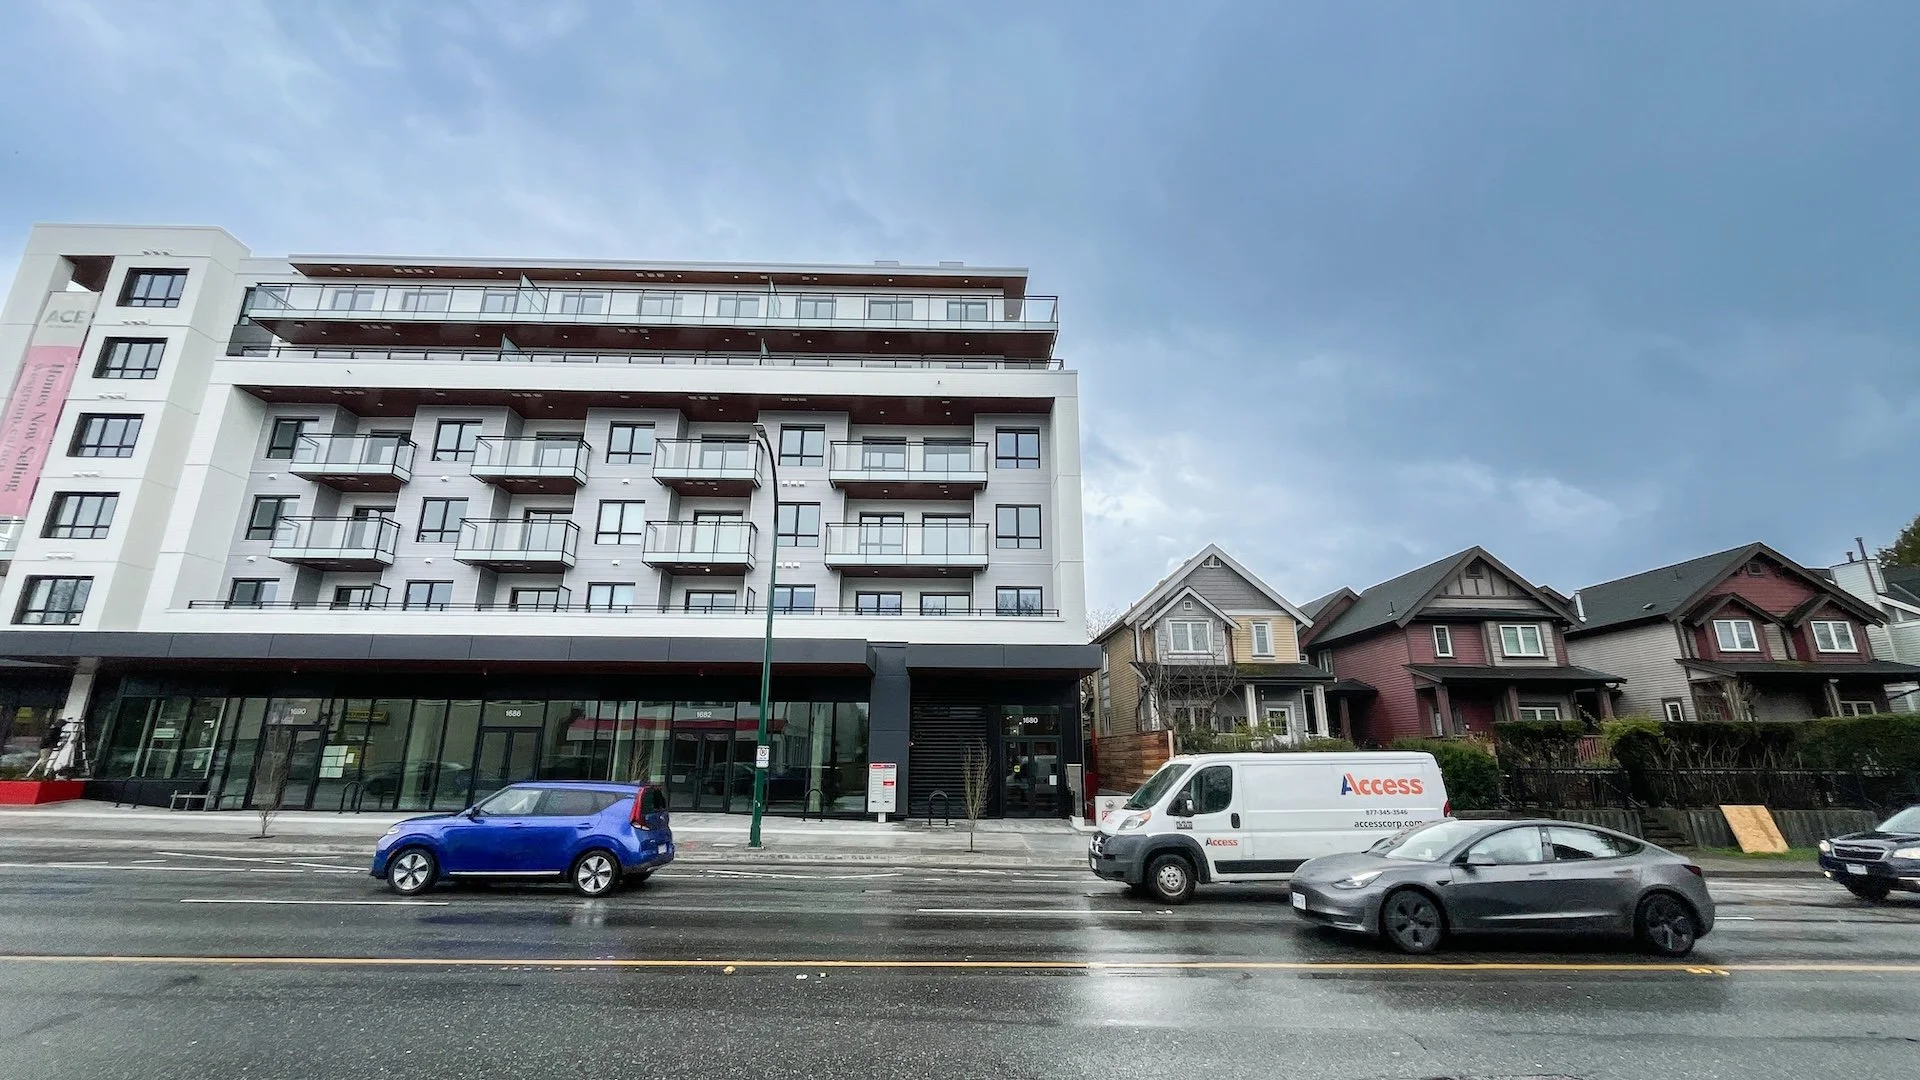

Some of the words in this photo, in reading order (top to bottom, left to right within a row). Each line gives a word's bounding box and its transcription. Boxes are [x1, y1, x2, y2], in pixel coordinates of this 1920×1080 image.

[44, 310, 87, 324] ACE
[36, 364, 65, 407] Homes
[24, 412, 47, 439] Now
[4, 445, 36, 492] Selling
[1341, 773, 1424, 796] Access
[1205, 837, 1238, 847] Access
